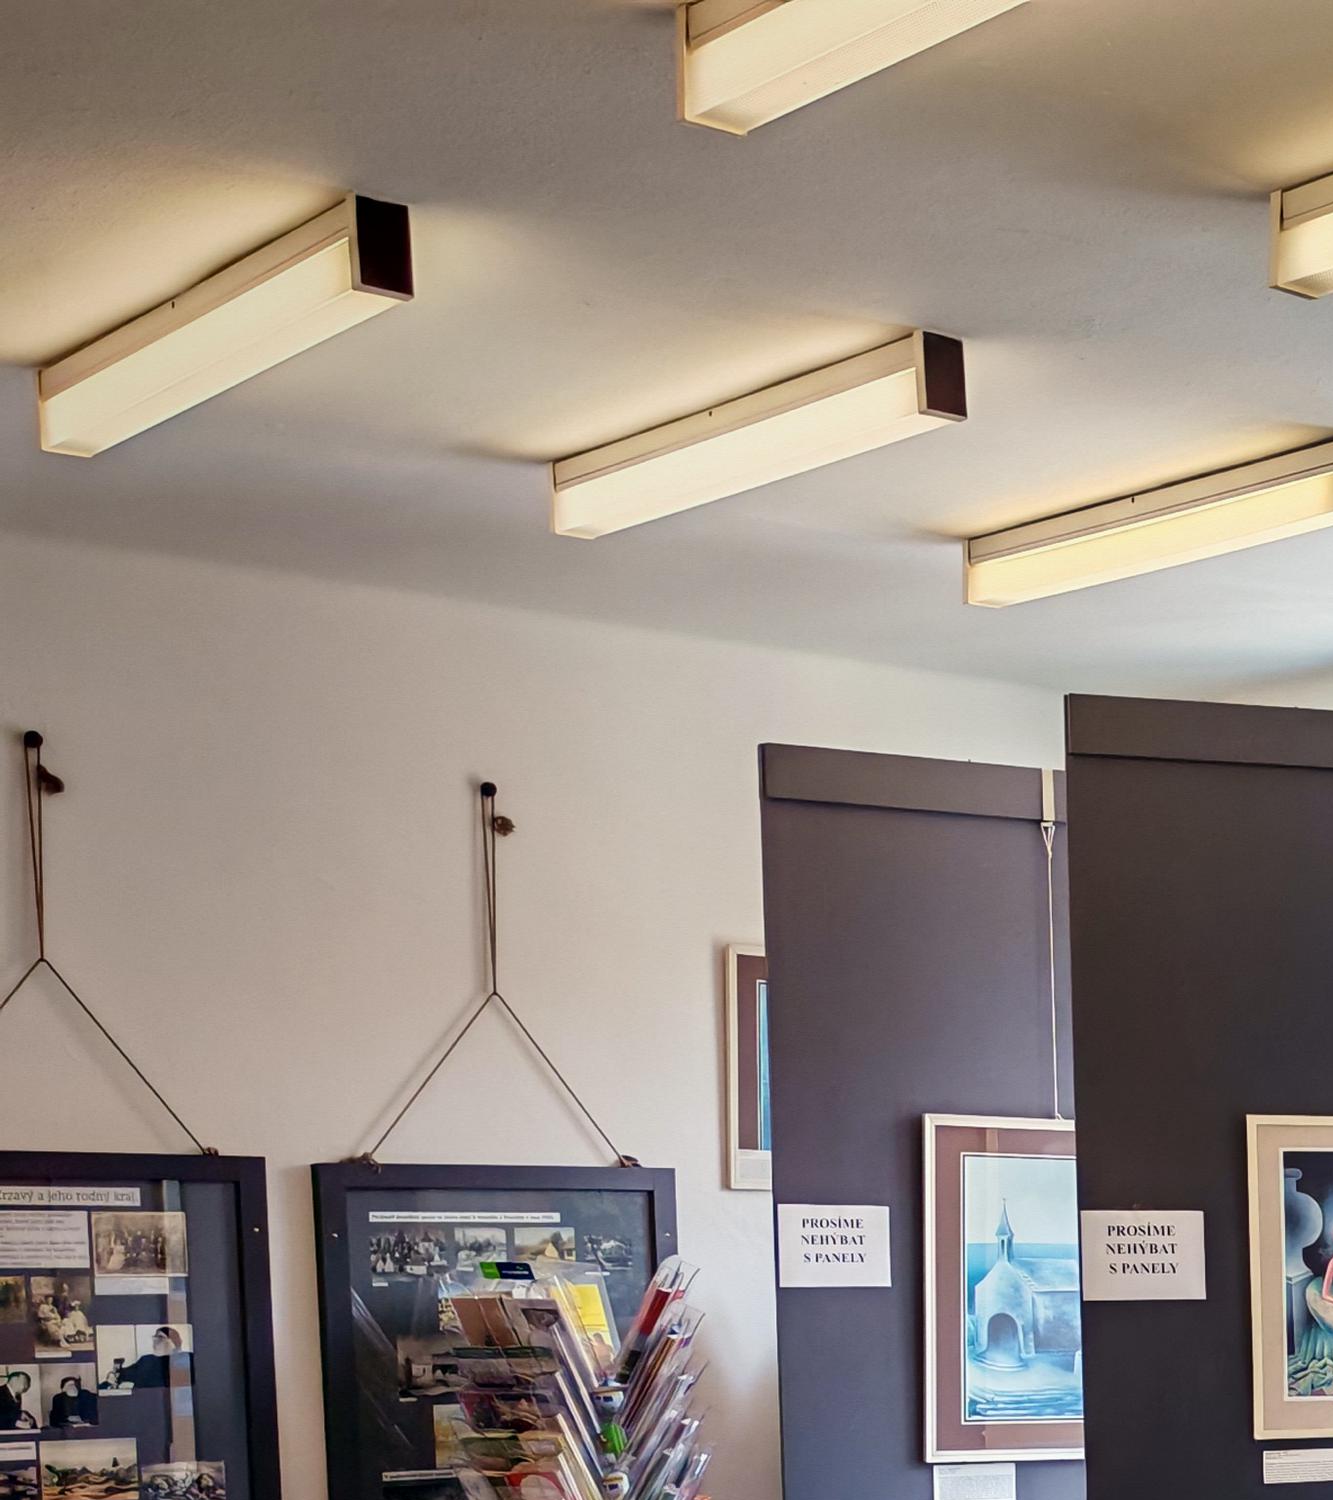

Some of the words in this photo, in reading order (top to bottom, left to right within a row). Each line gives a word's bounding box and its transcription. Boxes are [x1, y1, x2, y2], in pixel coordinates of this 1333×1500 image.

[38, 1191, 44, 1201] a
[48, 1189, 73, 1203] jeho
[802, 1216, 864, 1229] PROSÍME
[1107, 1221, 1176, 1236] PROSÍME
[801, 1232, 866, 1245] NEHÝBAT
[1105, 1240, 1178, 1255] NEHÝBAT
[803, 1253, 811, 1263] S
[815, 1253, 867, 1263] PANELY
[1109, 1263, 1118, 1274] S
[1121, 1262, 1180, 1274] PANELY
